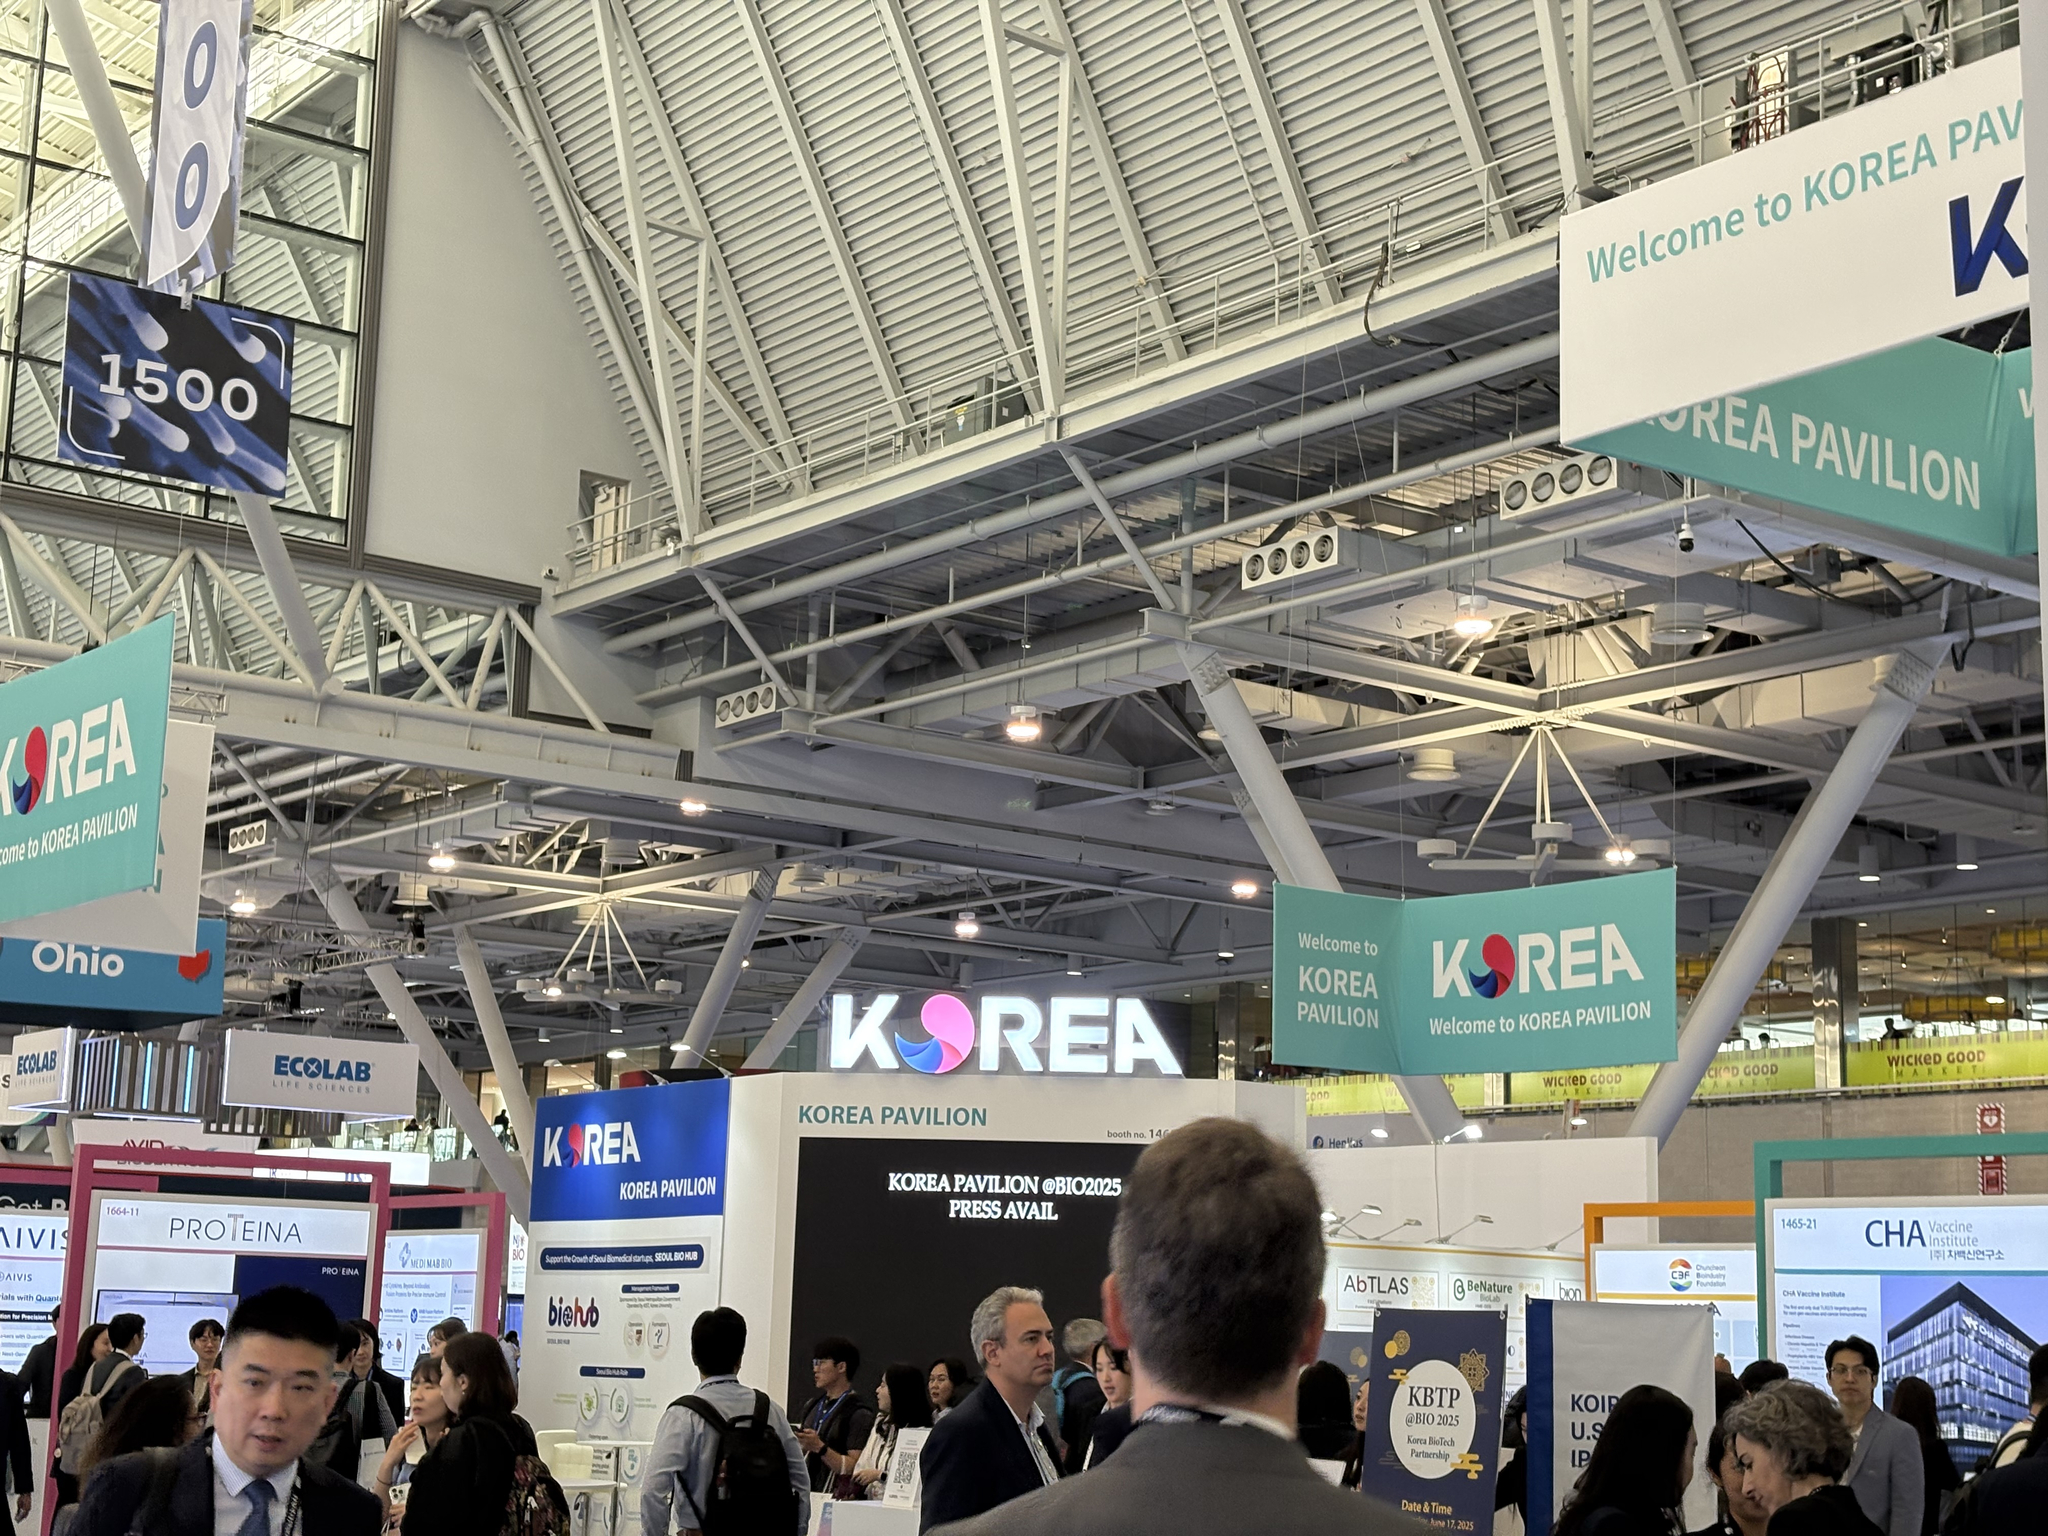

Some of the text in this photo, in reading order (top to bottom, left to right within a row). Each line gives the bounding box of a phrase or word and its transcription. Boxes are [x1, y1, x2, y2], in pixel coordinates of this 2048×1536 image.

[1586, 208, 1745, 284] Welcome
[1754, 192, 1792, 228] to
[1803, 132, 1938, 213] KOREA
[99, 353, 258, 421] 1500
[1646, 396, 1981, 510] OREA PAVILION
[27, 838, 39, 859] to
[41, 821, 80, 857] KOREA
[82, 803, 139, 845] PAVILION
[1298, 931, 1378, 957] Welcome to
[32, 941, 124, 978] Ohio
[1432, 922, 1645, 1000] KOREA
[1299, 965, 1379, 1000] KOREA
[1297, 1001, 1379, 1029] PAVILION
[1430, 1000, 1652, 1036] Welcome to KOREA PAVILION
[830, 993, 1183, 1075] KOREA
[16, 1050, 57, 1076] ECOLAB
[274, 1054, 371, 1082] ECOLAB
[1947, 1050, 1986, 1064] GOOD
[1590, 1072, 1622, 1086] GOOD
[1743, 1063, 1778, 1077] GOOD
[272, 1079, 371, 1095] LIFE SCIENCES
[799, 1104, 988, 1127] KOREA PAVILION
[543, 1121, 641, 1168] KOREA
[1107, 1129, 1132, 1139] booth
[620, 1176, 717, 1200] KOREA PAVILION
[888, 1172, 1122, 1197] KOREA PAVILION @BIO2025
[106, 1206, 140, 1217] 1664-11
[948, 1199, 1059, 1221] PRESS AVAIL
[169, 1213, 302, 1244] PROTEINA
[1781, 1218, 1818, 1230] 1465-21
[1865, 1219, 1928, 1248] CHA
[1928, 1220, 1973, 1233] Vaccine
[1929, 1235, 1979, 1247] Institute
[545, 1254, 564, 1265] Support
[572, 1253, 588, 1263] Growth
[594, 1254, 606, 1263] Seoul
[607, 1253, 633, 1263] Biomedical
[655, 1252, 673, 1261] SEOUL
[674, 1252, 684, 1261] BIO
[685, 1251, 698, 1260] HUB
[1344, 1274, 1409, 1295] AbTLAS
[1467, 1279, 1513, 1295] BeNature
[17, 1294, 34, 1302] with
[36, 1294, 61, 1303] Quant
[21, 1313, 47, 1321] Precision
[548, 1296, 599, 1328] biohub
[1407, 1386, 1460, 1409] KBTP
[1405, 1412, 1460, 1428] @BIO 2025
[1407, 1434, 1455, 1448] Korea BioTech
[1410, 1448, 1451, 1463] Partnership
[1401, 1499, 1453, 1516] Date & Time
[1457, 1520, 1474, 1531] 2025
